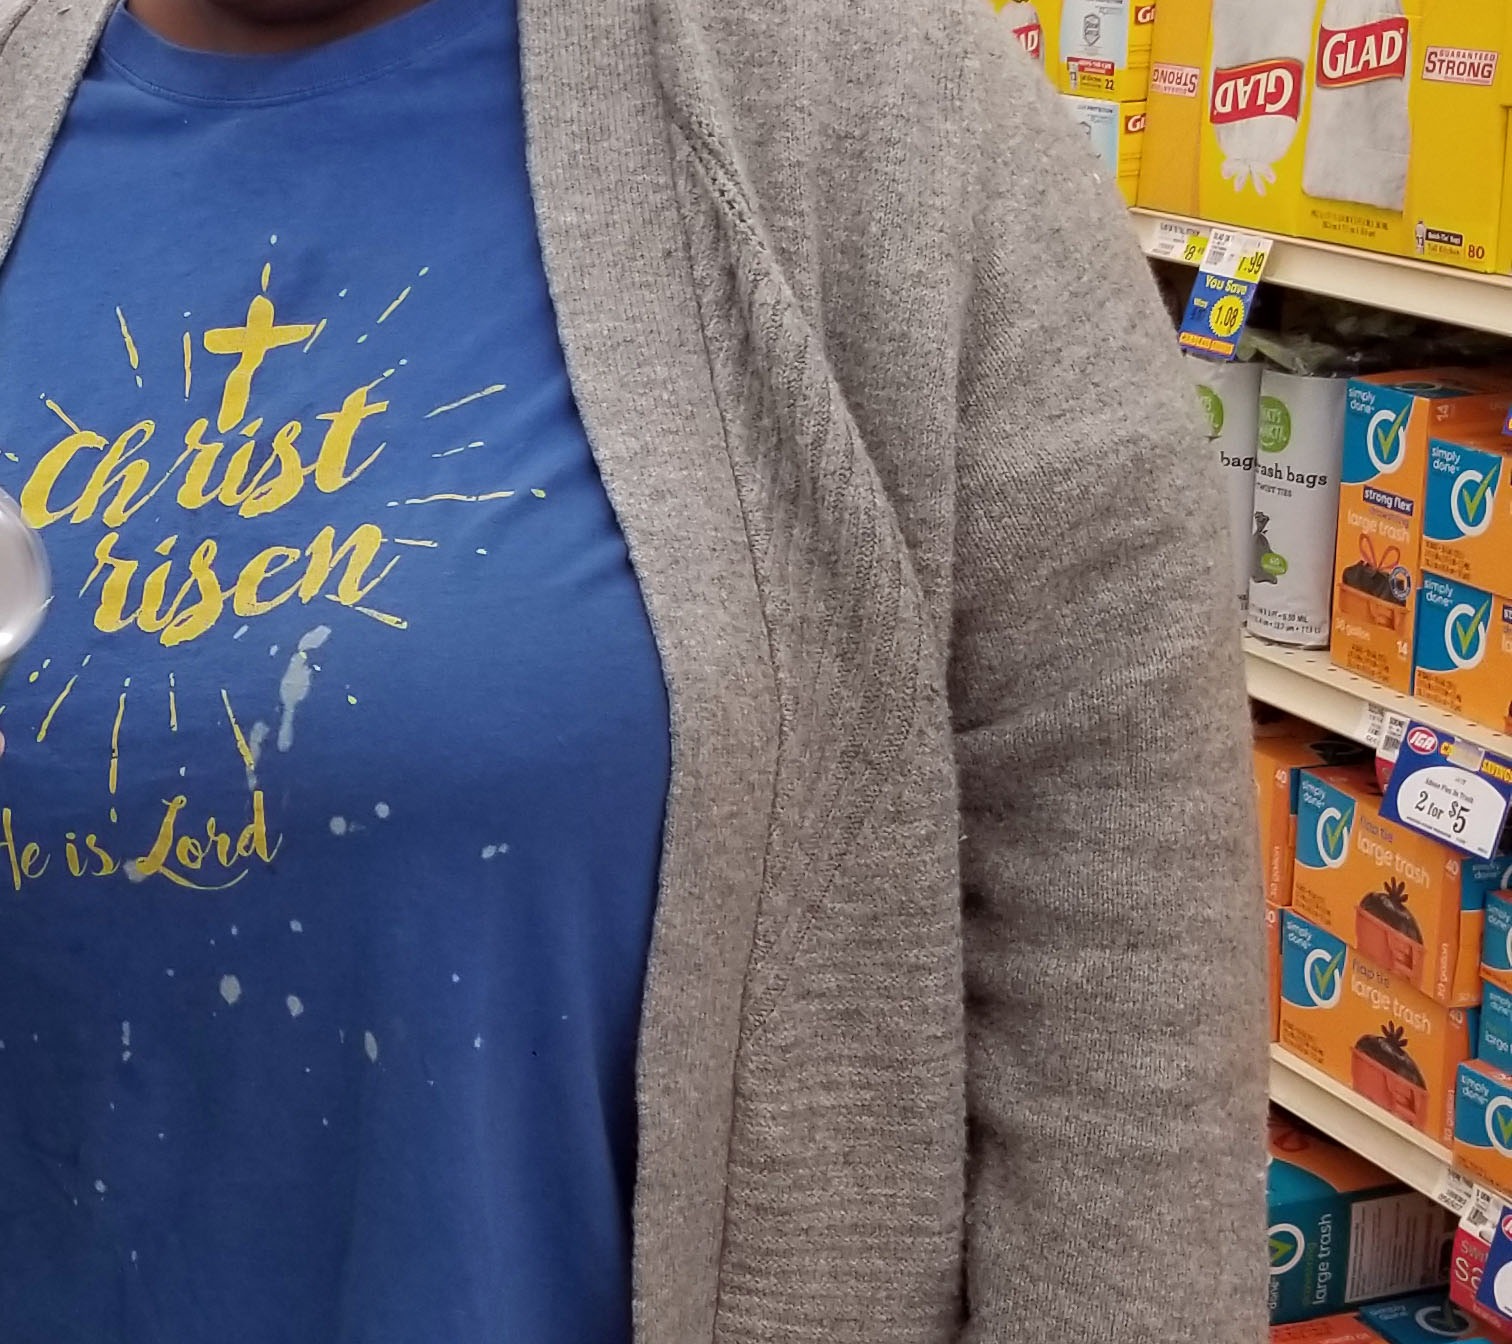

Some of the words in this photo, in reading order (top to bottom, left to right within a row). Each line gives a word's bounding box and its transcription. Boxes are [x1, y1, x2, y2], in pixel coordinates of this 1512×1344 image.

[1321, 29, 1403, 80] GLAD
[1425, 50, 1494, 80] STRONG
[1438, 48, 1497, 61] GUARANTEED
[1104, 78, 1115, 91] 22
[1152, 68, 1198, 93] STRONG
[1214, 67, 1294, 114] GLAD
[1467, 244, 1486, 260] 80
[1206, 274, 1224, 290] You
[1224, 279, 1248, 296] Save
[1214, 304, 1239, 328] 1.08
[1348, 387, 1376, 406] simply
[1350, 399, 1372, 414] done
[1220, 451, 1256, 471] bag
[1431, 446, 1461, 465] simply
[1432, 458, 1456, 474] done
[1286, 466, 1328, 489] bags
[1364, 488, 1393, 508] strong
[1392, 494, 1412, 512] flex
[1347, 511, 1378, 535] large
[1378, 519, 1411, 544] trash
[79, 522, 401, 647] risen
[1423, 578, 1454, 598] simply
[1425, 590, 1449, 606] done
[1396, 639, 1408, 656] 14
[1408, 730, 1437, 752] IGA
[1274, 769, 1287, 784] 40
[1414, 790, 1429, 813] 2
[1427, 802, 1445, 820] for
[1448, 800, 1471, 834] $5
[65, 831, 121, 878] is
[136, 790, 284, 891] Lord
[1357, 831, 1393, 868] large
[1393, 850, 1431, 889] trash
[1351, 975, 1392, 1013] large
[1391, 997, 1432, 1036] trash
[1484, 1033, 1510, 1052] large
[1318, 1212, 1332, 1262] trash
[1312, 1262, 1331, 1305] large
